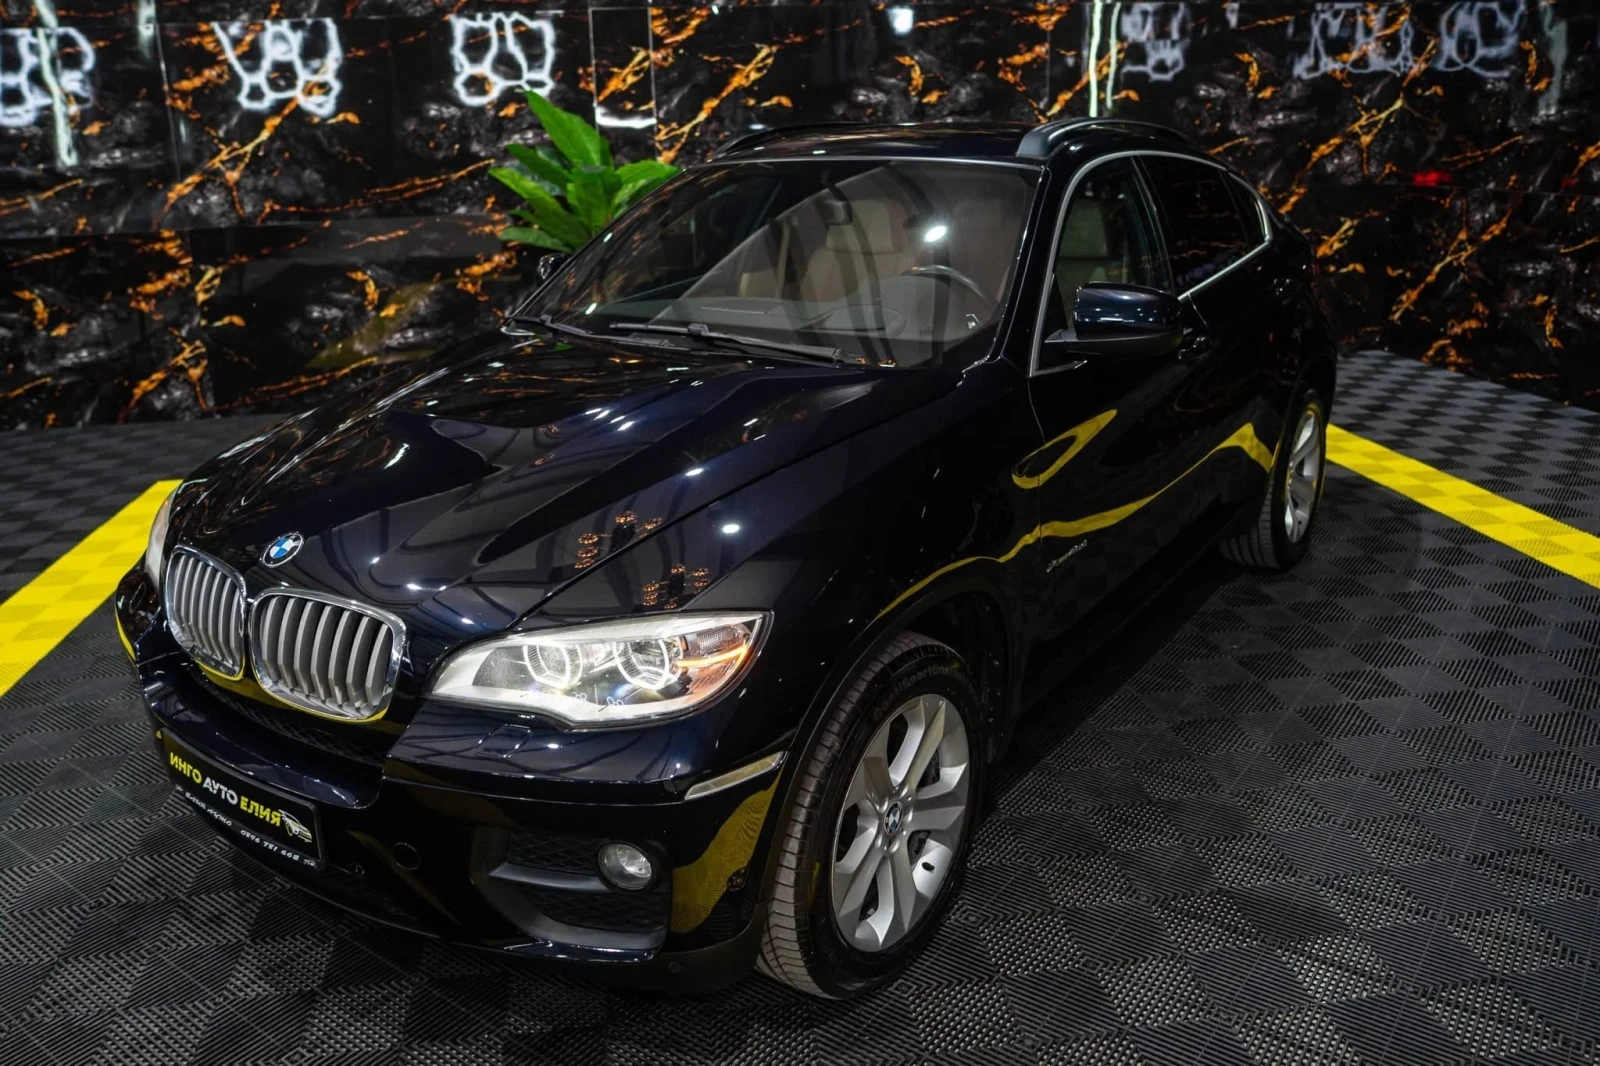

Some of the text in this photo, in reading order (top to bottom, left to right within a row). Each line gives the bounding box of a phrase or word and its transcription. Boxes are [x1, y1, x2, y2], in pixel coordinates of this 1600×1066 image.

[169, 752, 202, 784] ИНГО
[203, 776, 239, 805] АУТО
[240, 796, 281, 827] ЕЛИЯ
